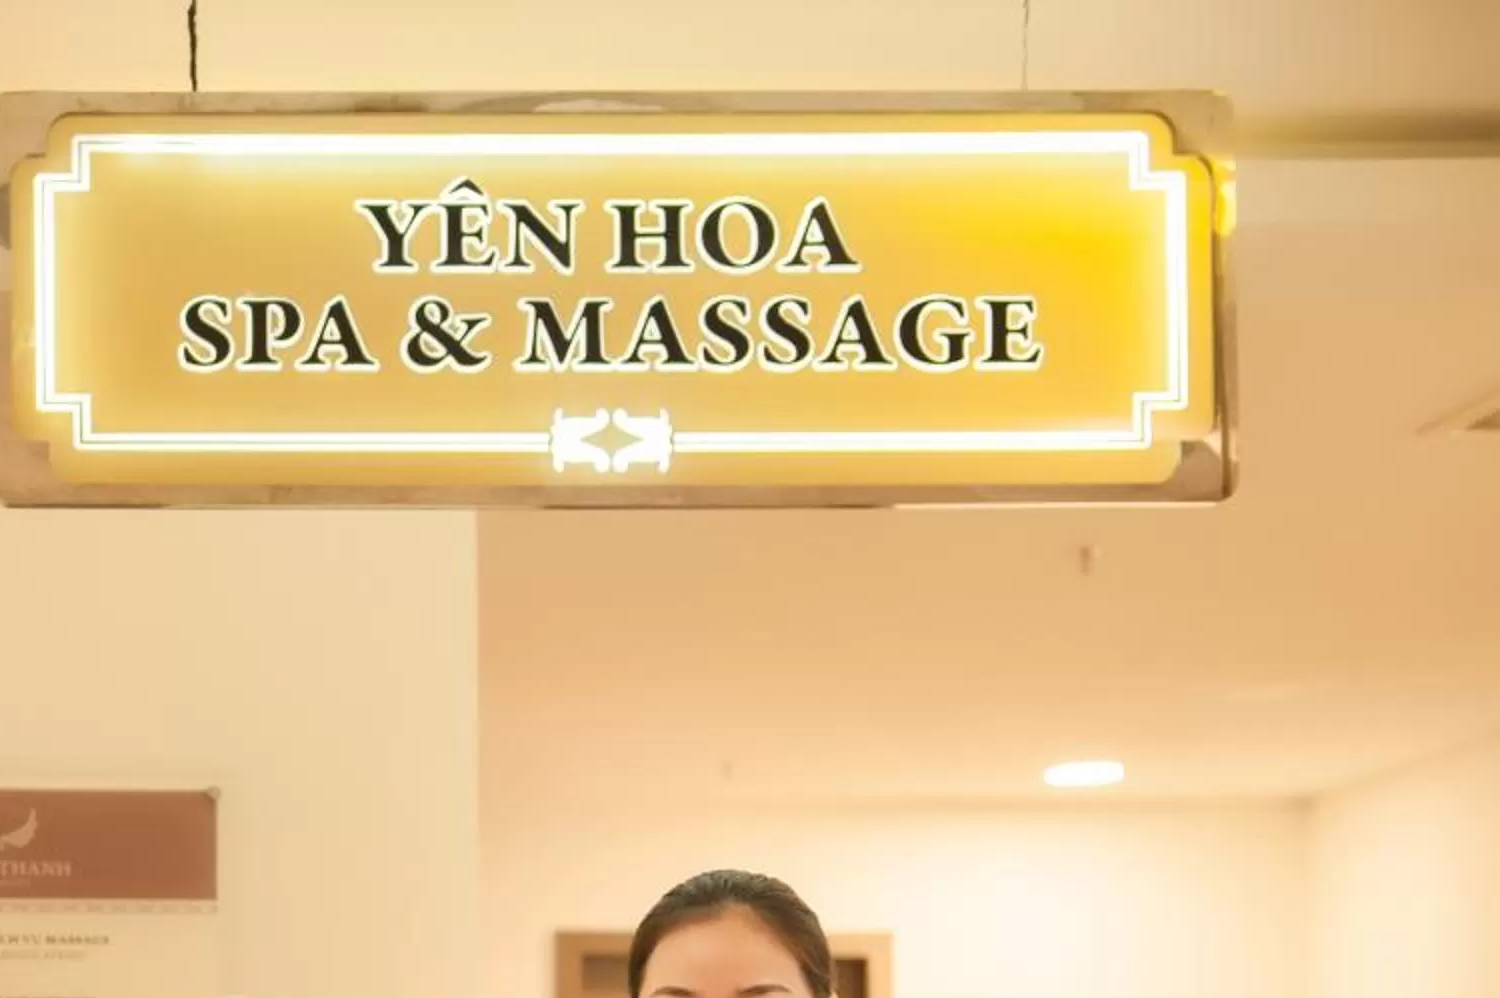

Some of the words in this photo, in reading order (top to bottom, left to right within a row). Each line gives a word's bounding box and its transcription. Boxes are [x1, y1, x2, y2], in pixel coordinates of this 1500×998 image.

[357, 176, 583, 270] YÊN
[606, 199, 861, 270] HOA
[181, 297, 378, 368] SPA
[403, 298, 492, 369] &
[516, 297, 1043, 368] MASSAGE
